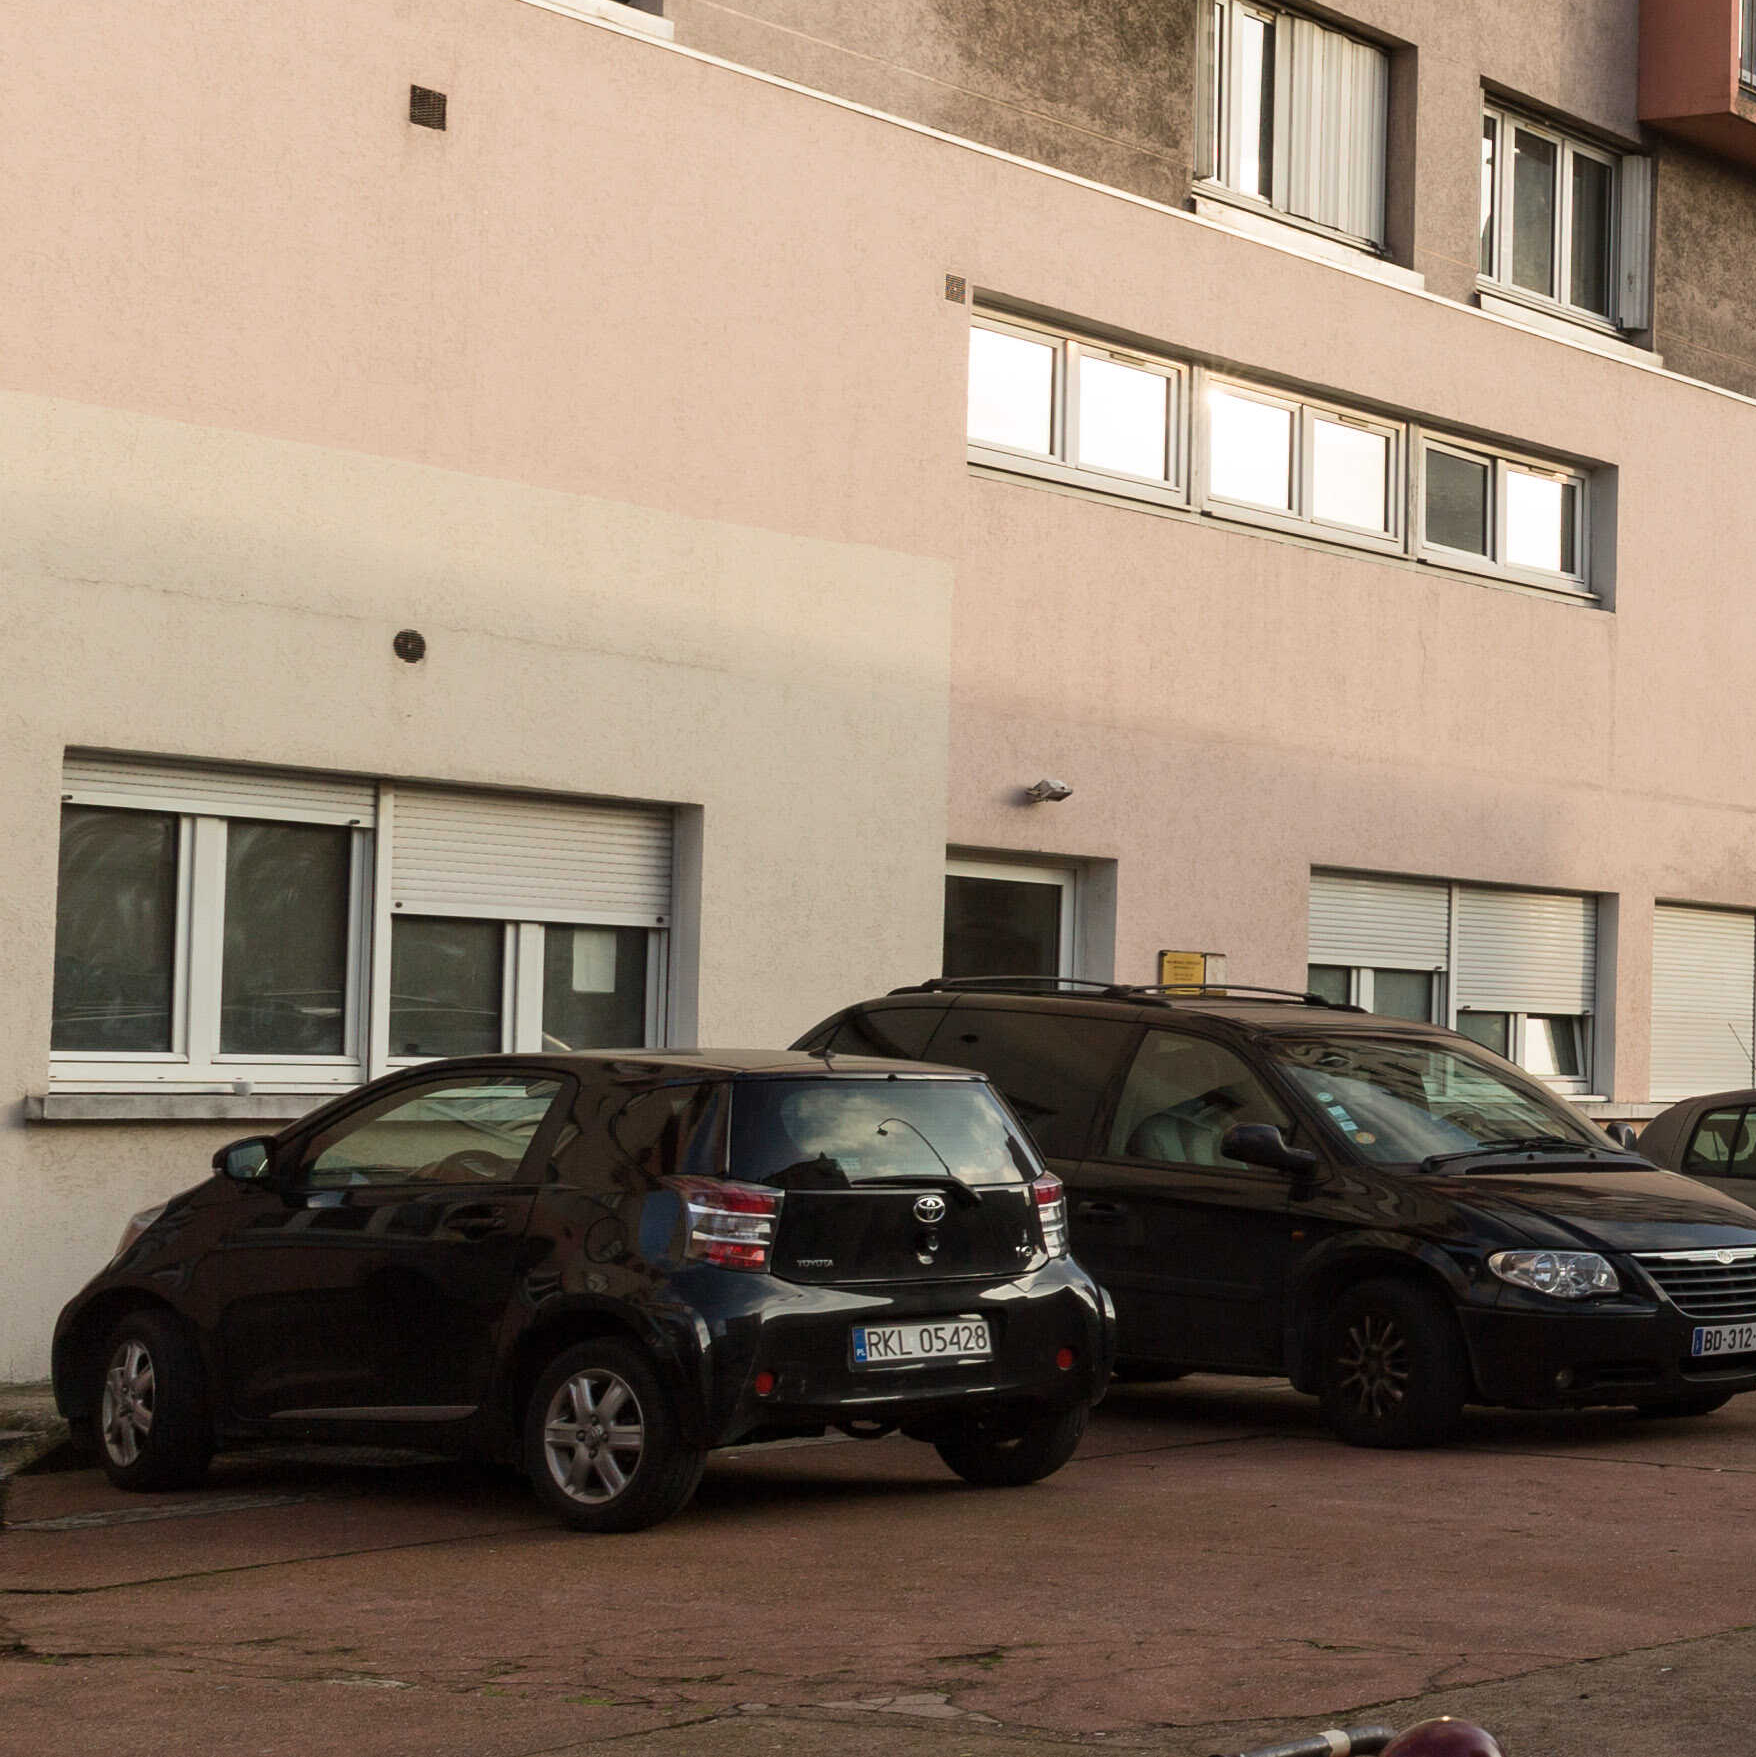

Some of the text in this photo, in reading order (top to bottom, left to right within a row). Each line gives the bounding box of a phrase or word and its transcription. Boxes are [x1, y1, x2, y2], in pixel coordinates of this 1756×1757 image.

[797, 1258, 834, 1267] TOYOTA
[867, 1325, 987, 1357] RKL 05428
